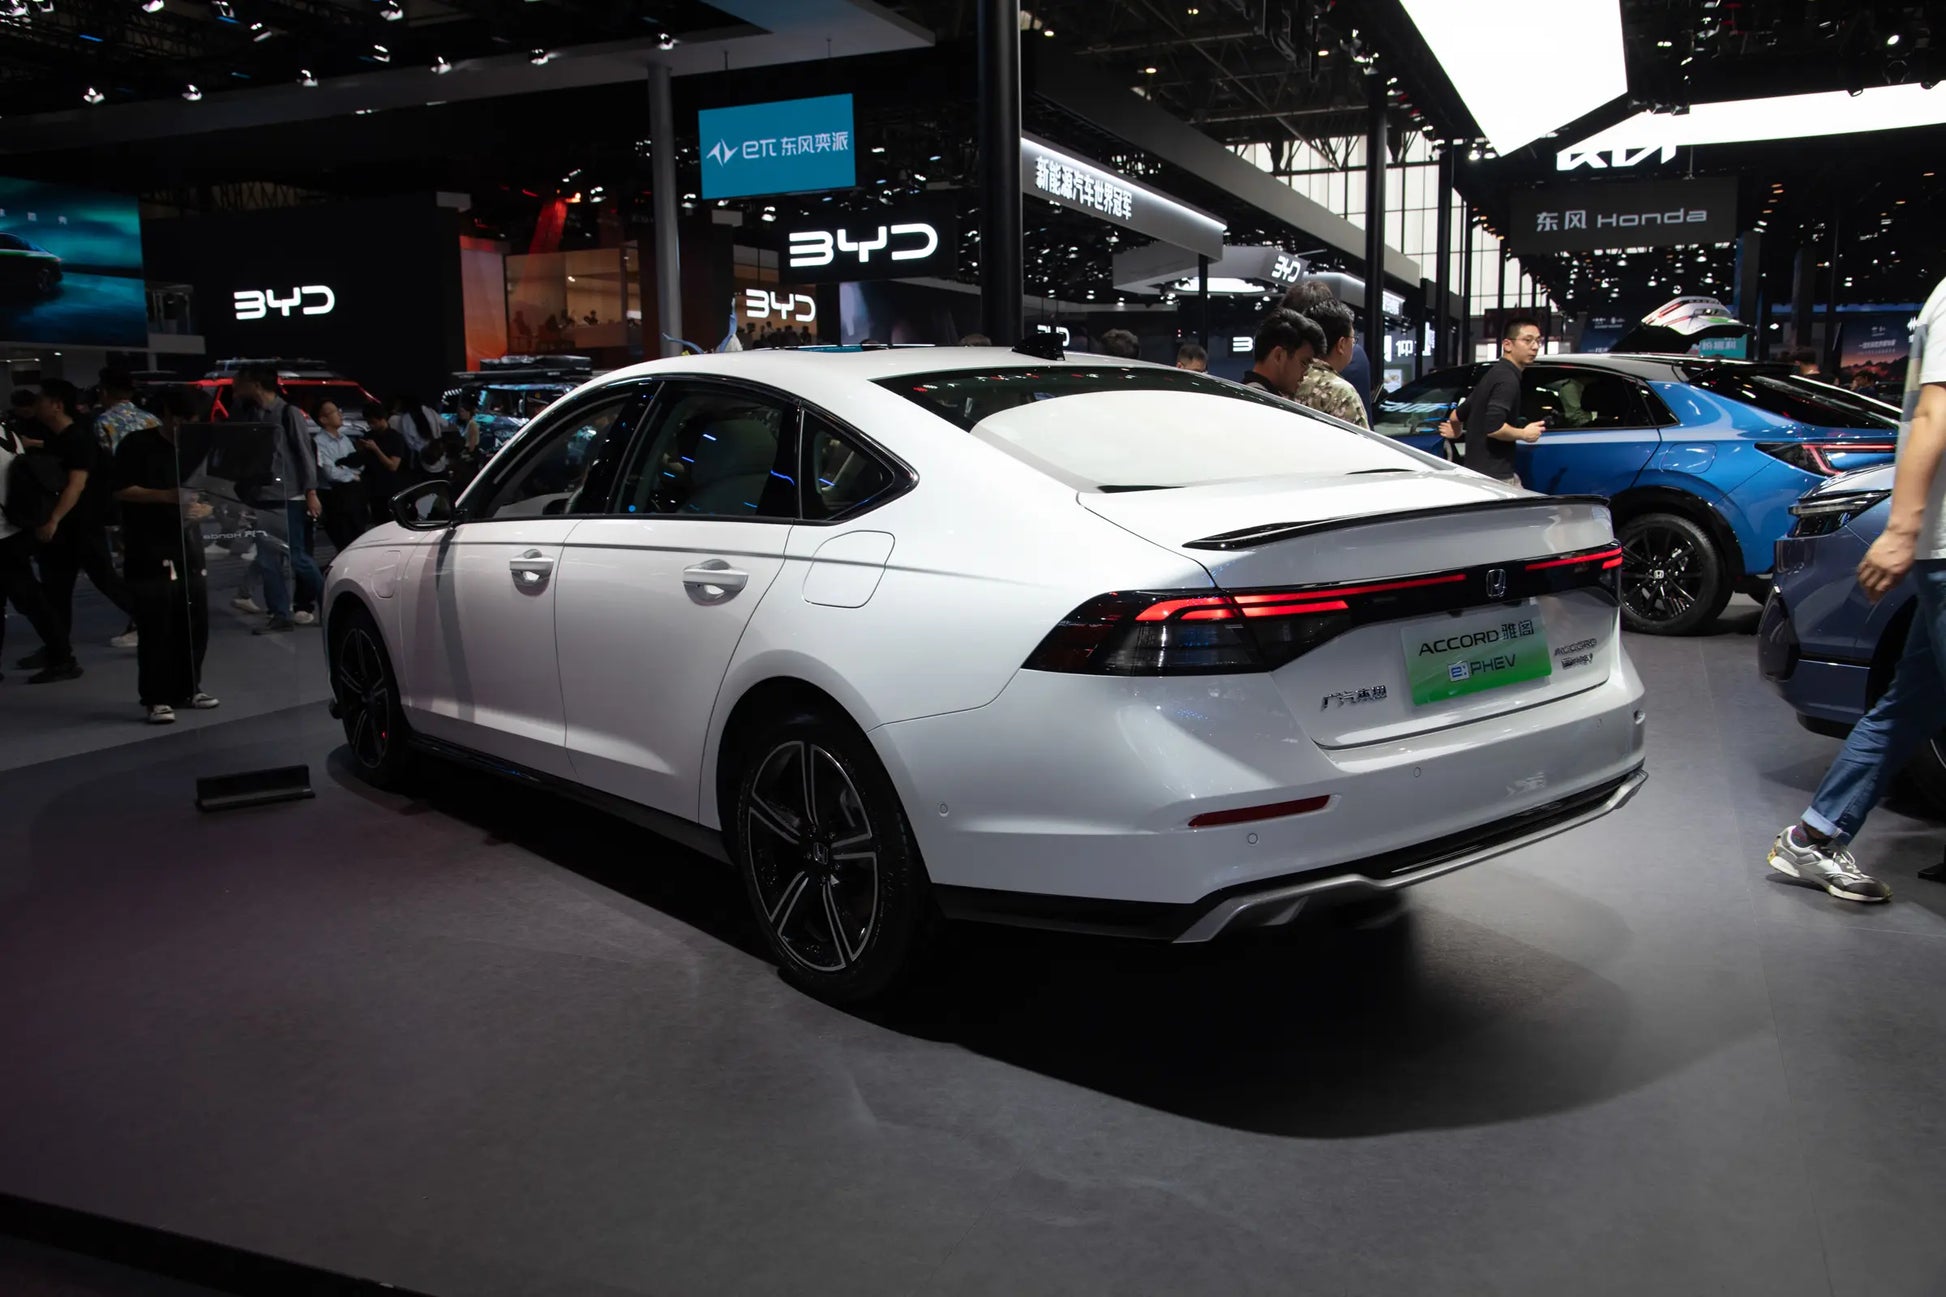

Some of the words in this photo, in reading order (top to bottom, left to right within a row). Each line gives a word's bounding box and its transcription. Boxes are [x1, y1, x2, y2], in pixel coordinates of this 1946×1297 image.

[780, 131, 849, 156] 东风奕派
[1036, 155, 1132, 220] 新能源汽车世界冠军
[1536, 210, 1587, 232] 东风
[1596, 208, 1708, 228] Honda
[788, 223, 939, 267] BYD
[1271, 255, 1301, 283] BYD
[233, 285, 335, 320] BYD
[746, 288, 816, 322] BYD
[1419, 630, 1499, 656] ACCORD
